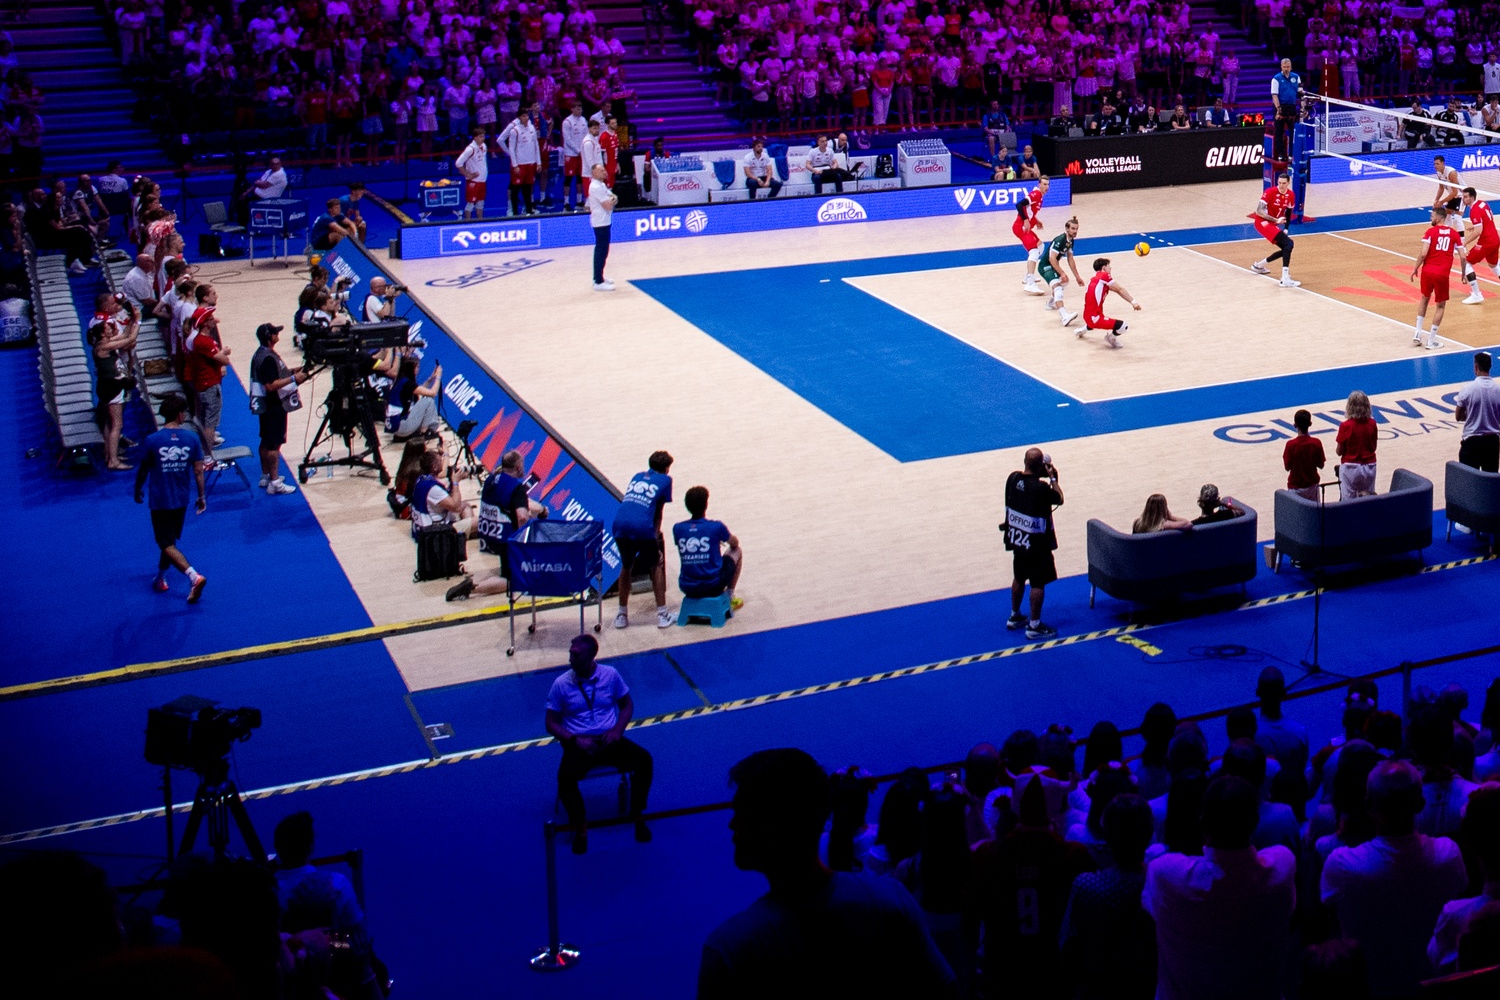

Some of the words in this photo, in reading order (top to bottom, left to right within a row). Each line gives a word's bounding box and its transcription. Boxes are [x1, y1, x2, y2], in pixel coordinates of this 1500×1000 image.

[1491, 70, 1497, 79] 8
[1085, 156, 1142, 167] VOLLEYBALL
[1085, 166, 1114, 175] NATIONS
[1116, 164, 1142, 172] LEAGUE
[636, 212, 682, 236] plus
[479, 228, 527, 244] ORLEN
[3, 317, 20, 326] E&E
[444, 373, 483, 416] GLIWICE
[159, 446, 191, 462] SOS
[1009, 513, 1041, 530] OFFICIAL
[679, 536, 710, 554] SOS
[1016, 887, 1041, 936] 9
